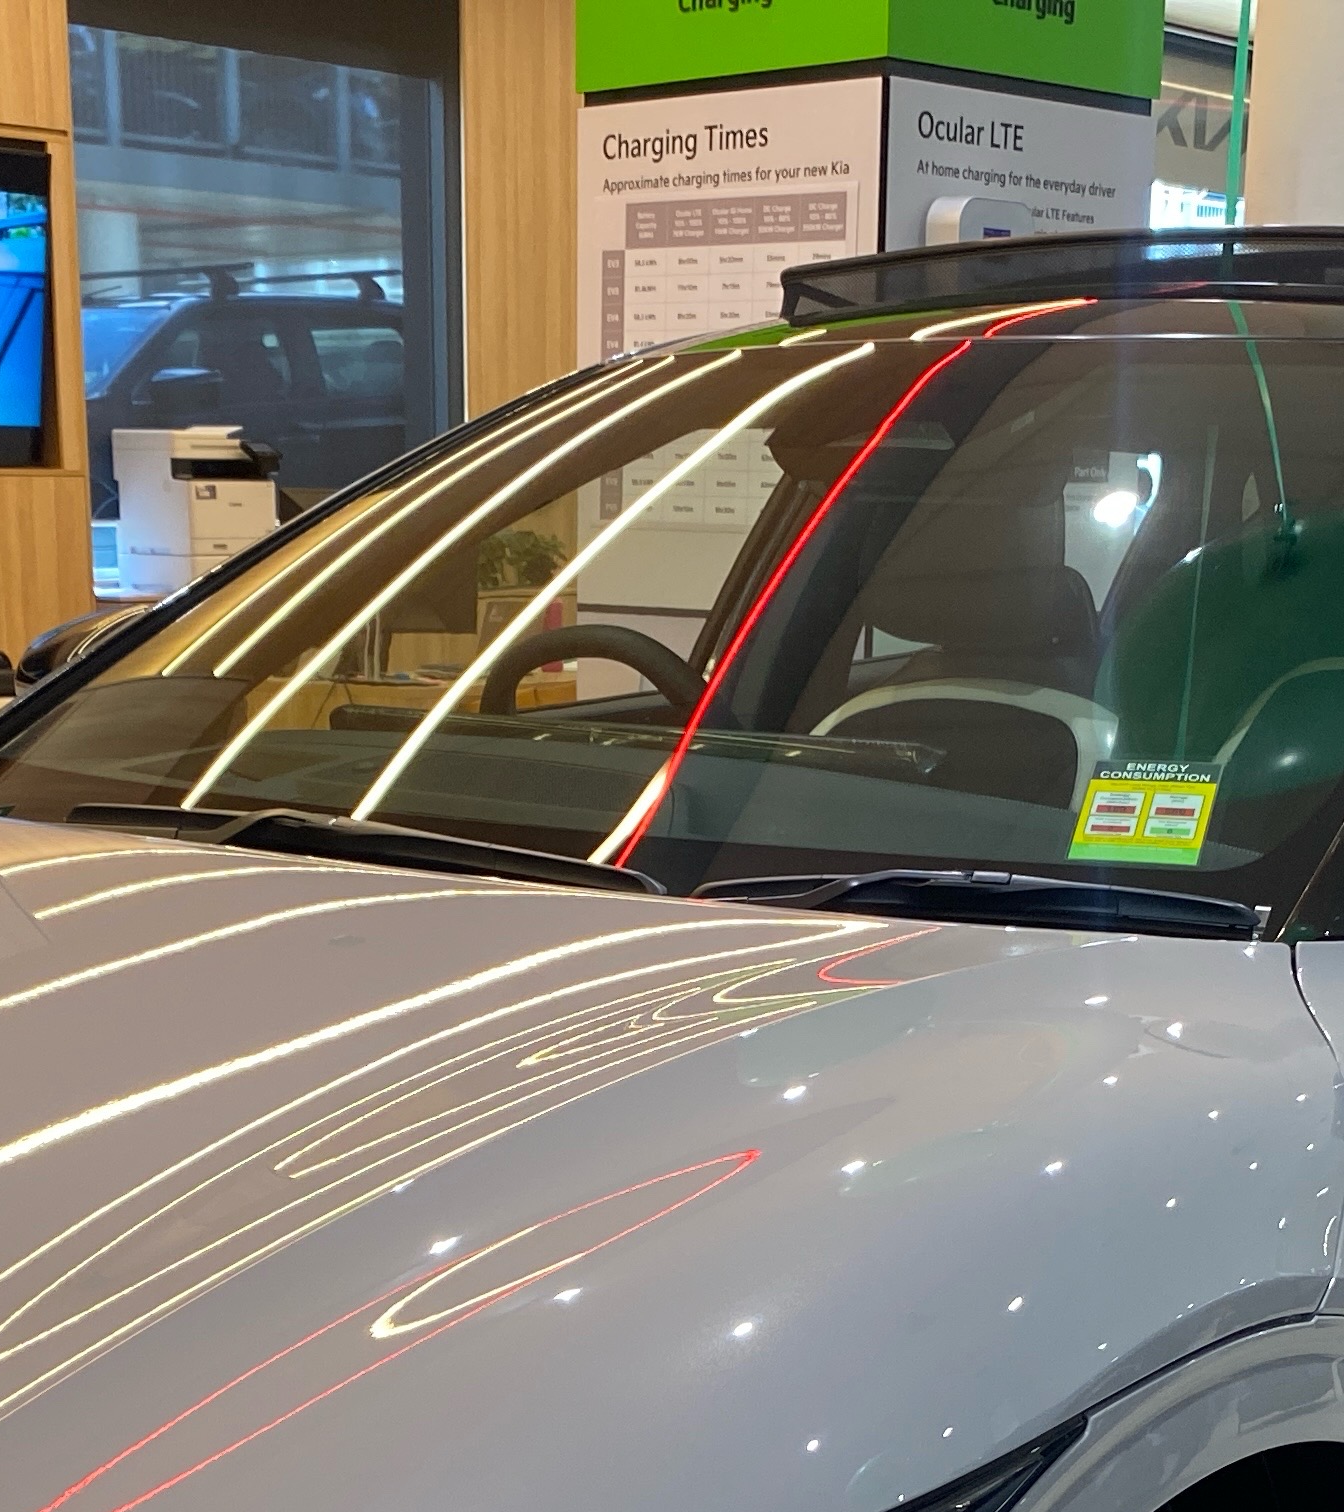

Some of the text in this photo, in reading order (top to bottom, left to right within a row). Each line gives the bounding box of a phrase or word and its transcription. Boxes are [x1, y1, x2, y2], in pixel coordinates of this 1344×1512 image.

[992, 0, 1074, 24] arging
[603, 124, 769, 162] Charging Times
[918, 111, 1024, 151] Ocular LTE
[603, 160, 850, 195] Approximate charging times for your new Kia
[916, 159, 1116, 199] At home charging for the everyday driver
[1046, 208, 1060, 220] LTE
[1062, 210, 1094, 225] Features
[1100, 771, 1211, 782] CONSUMPTION
[1126, 762, 1190, 772] ENERGY
